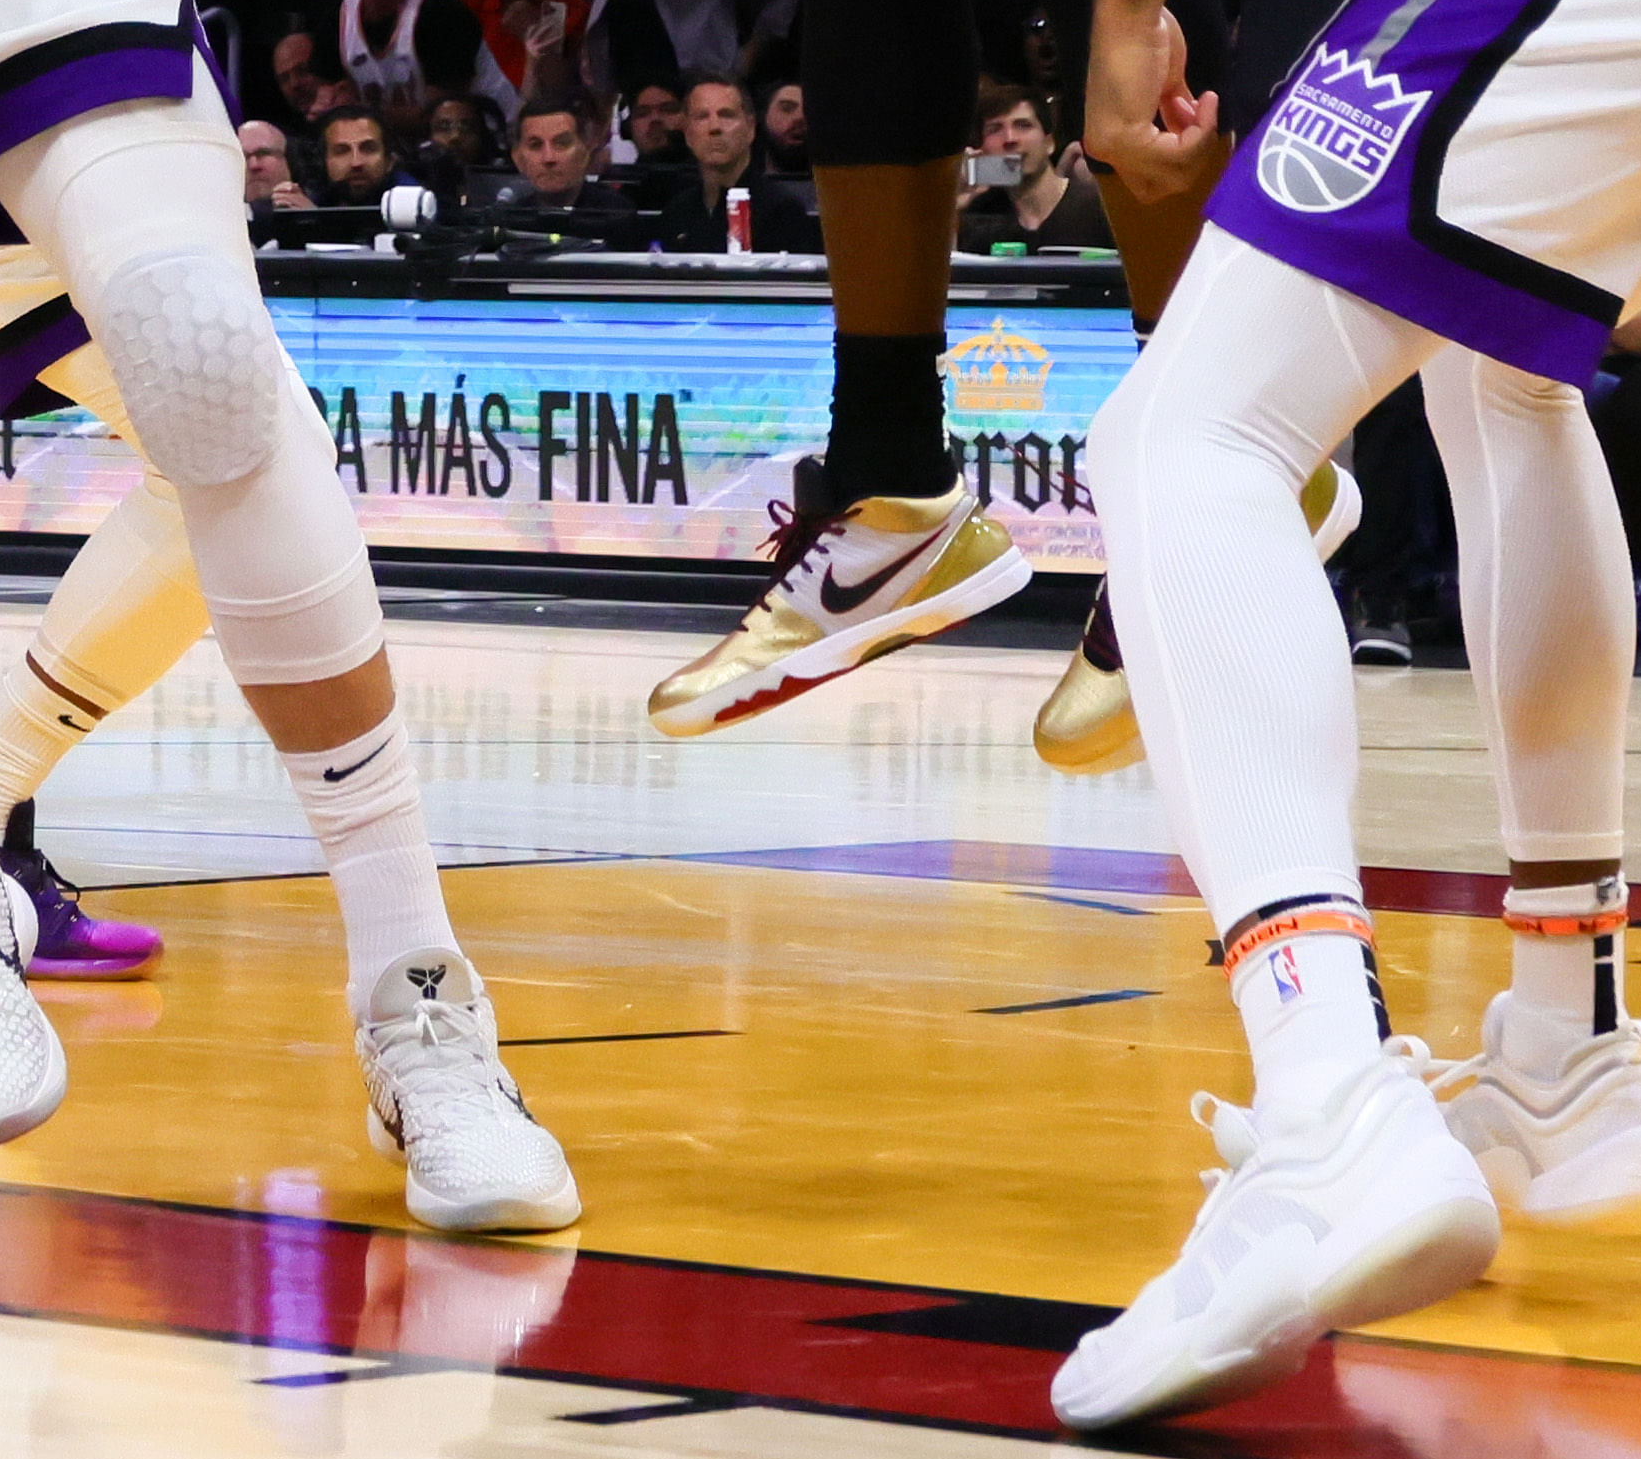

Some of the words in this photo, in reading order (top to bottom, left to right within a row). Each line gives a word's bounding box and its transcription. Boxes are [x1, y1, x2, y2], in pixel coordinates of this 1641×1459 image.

[1272, 100, 1388, 176] KINGS
[1296, 82, 1395, 139] SACRAMENTO
[390, 372, 511, 500] MÁS
[538, 388, 691, 507] FINA
